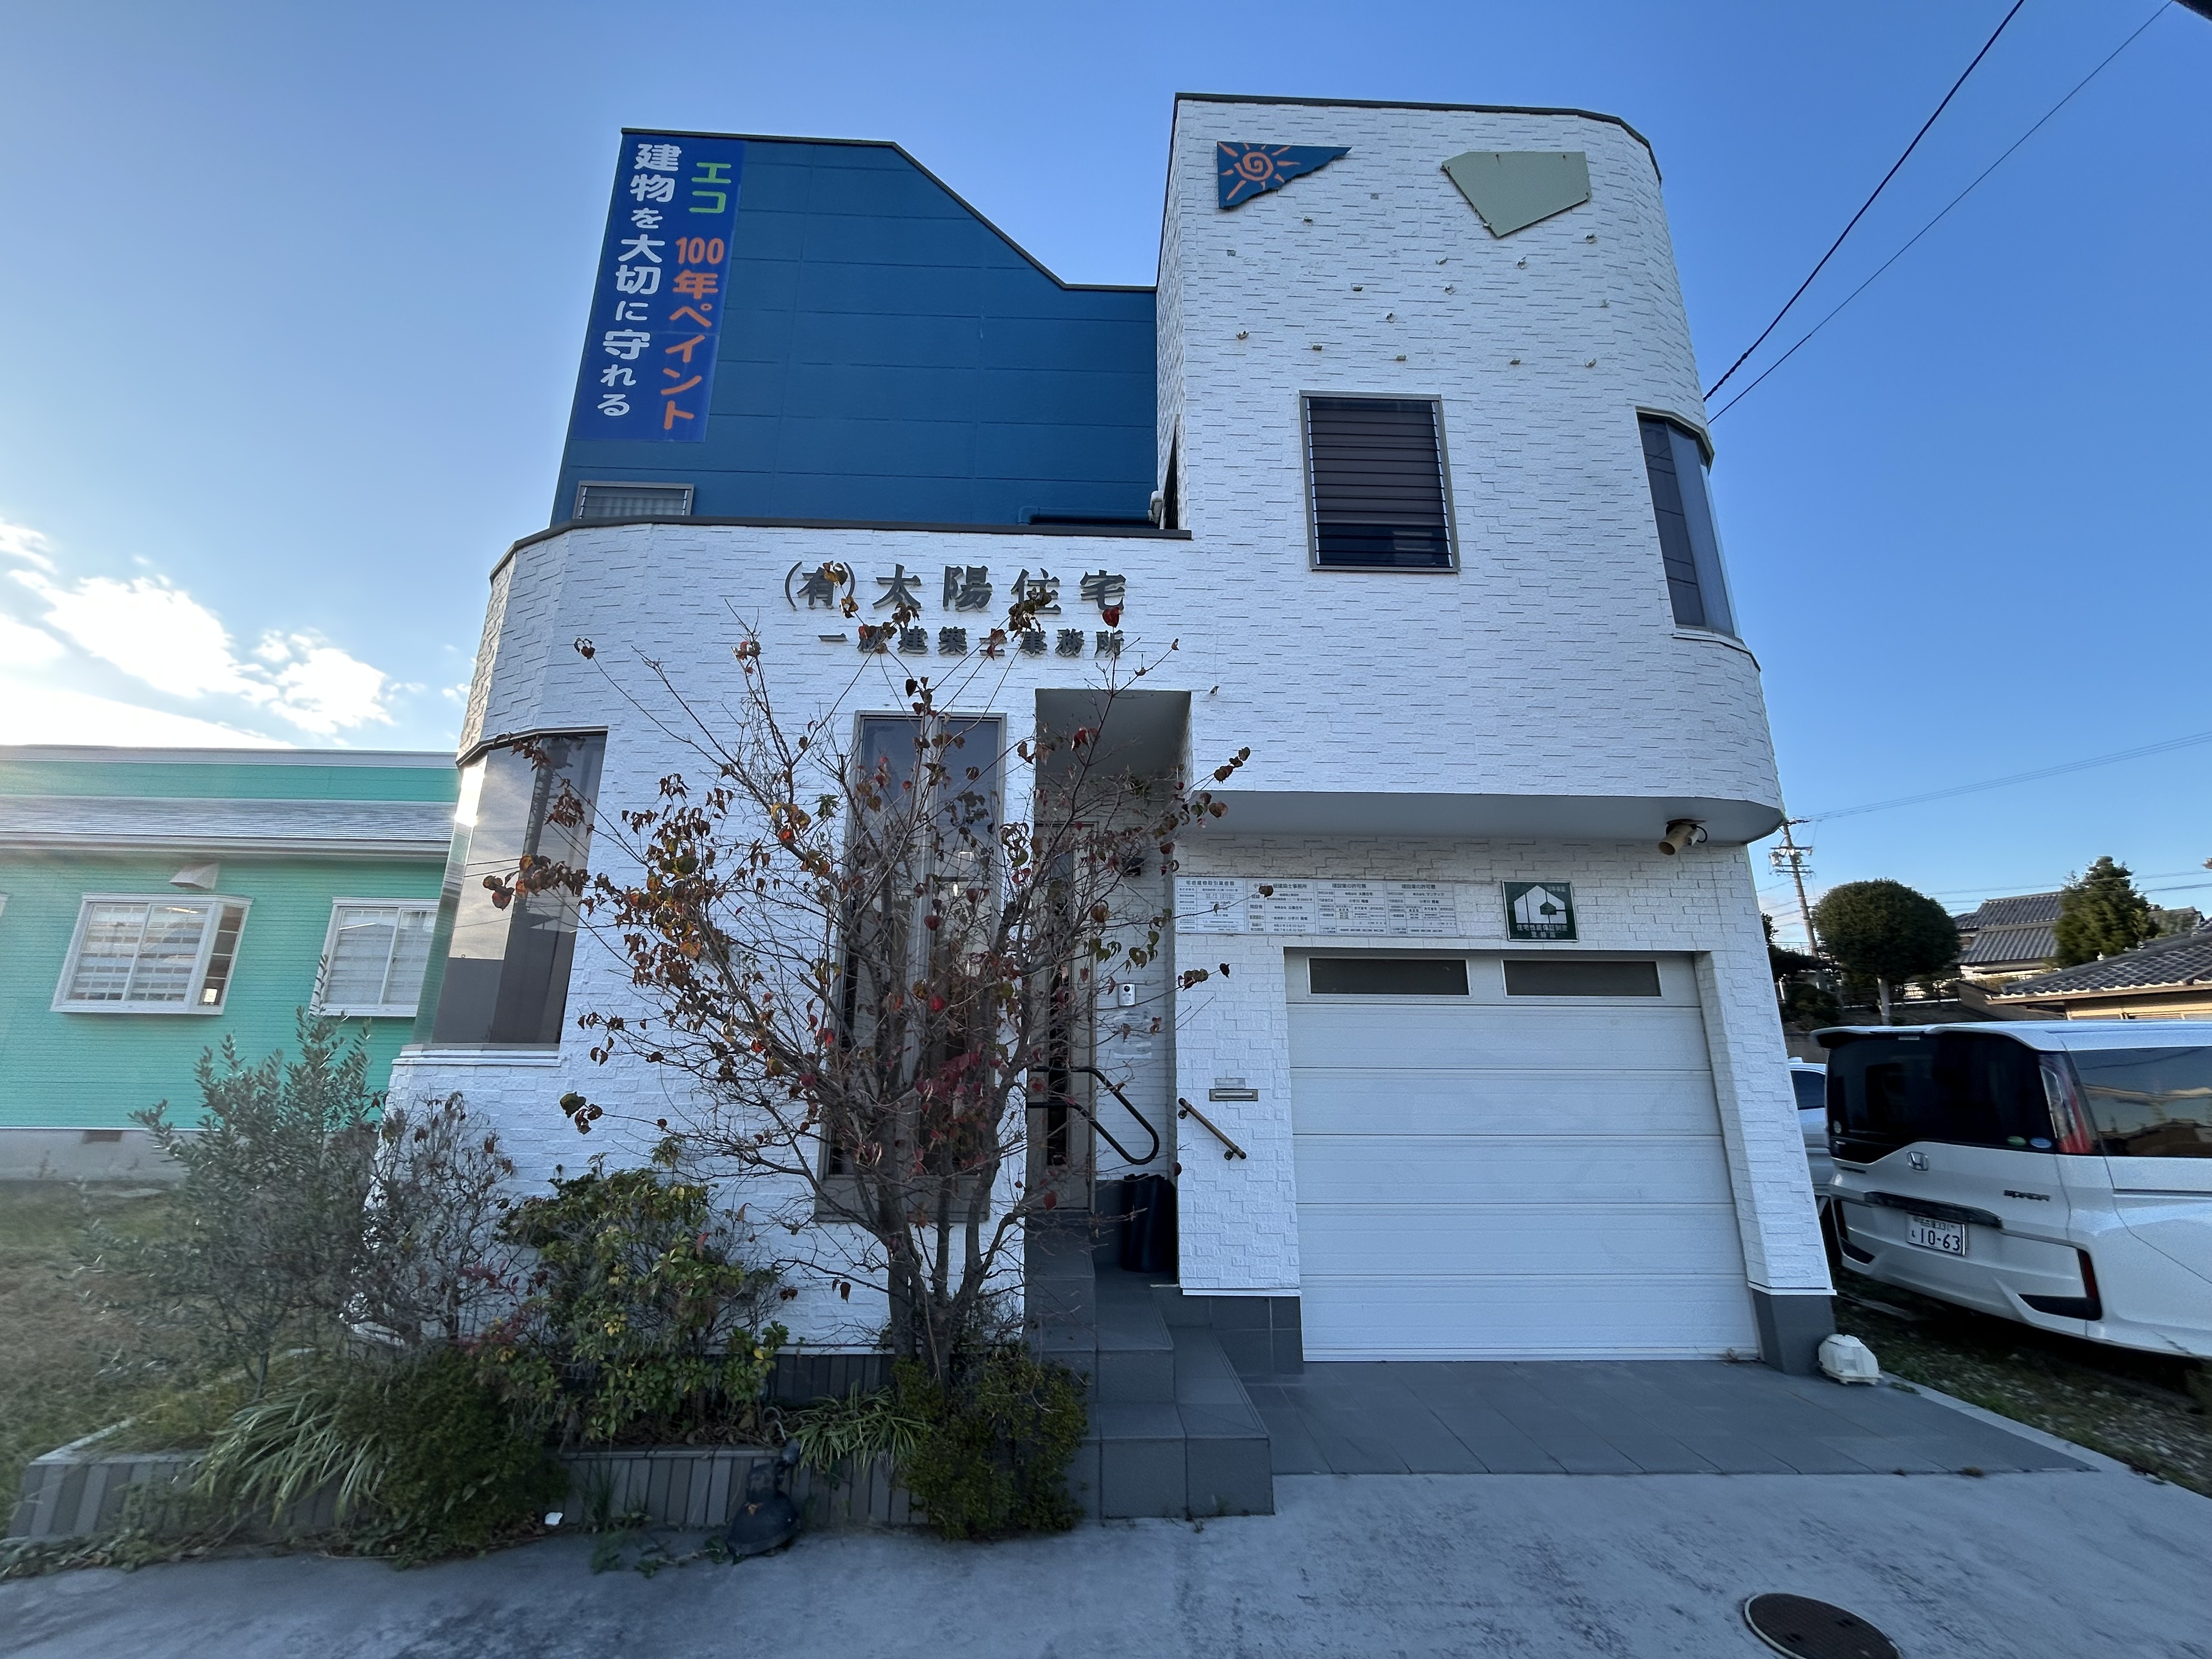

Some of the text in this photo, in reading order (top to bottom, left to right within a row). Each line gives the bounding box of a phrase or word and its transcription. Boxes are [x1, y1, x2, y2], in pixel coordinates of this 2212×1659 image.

[597, 144, 682, 417] 建物を大切に守れる
[661, 162, 732, 430] エコ 100年ペイント
[1921, 1228, 1960, 1251] 10-63
